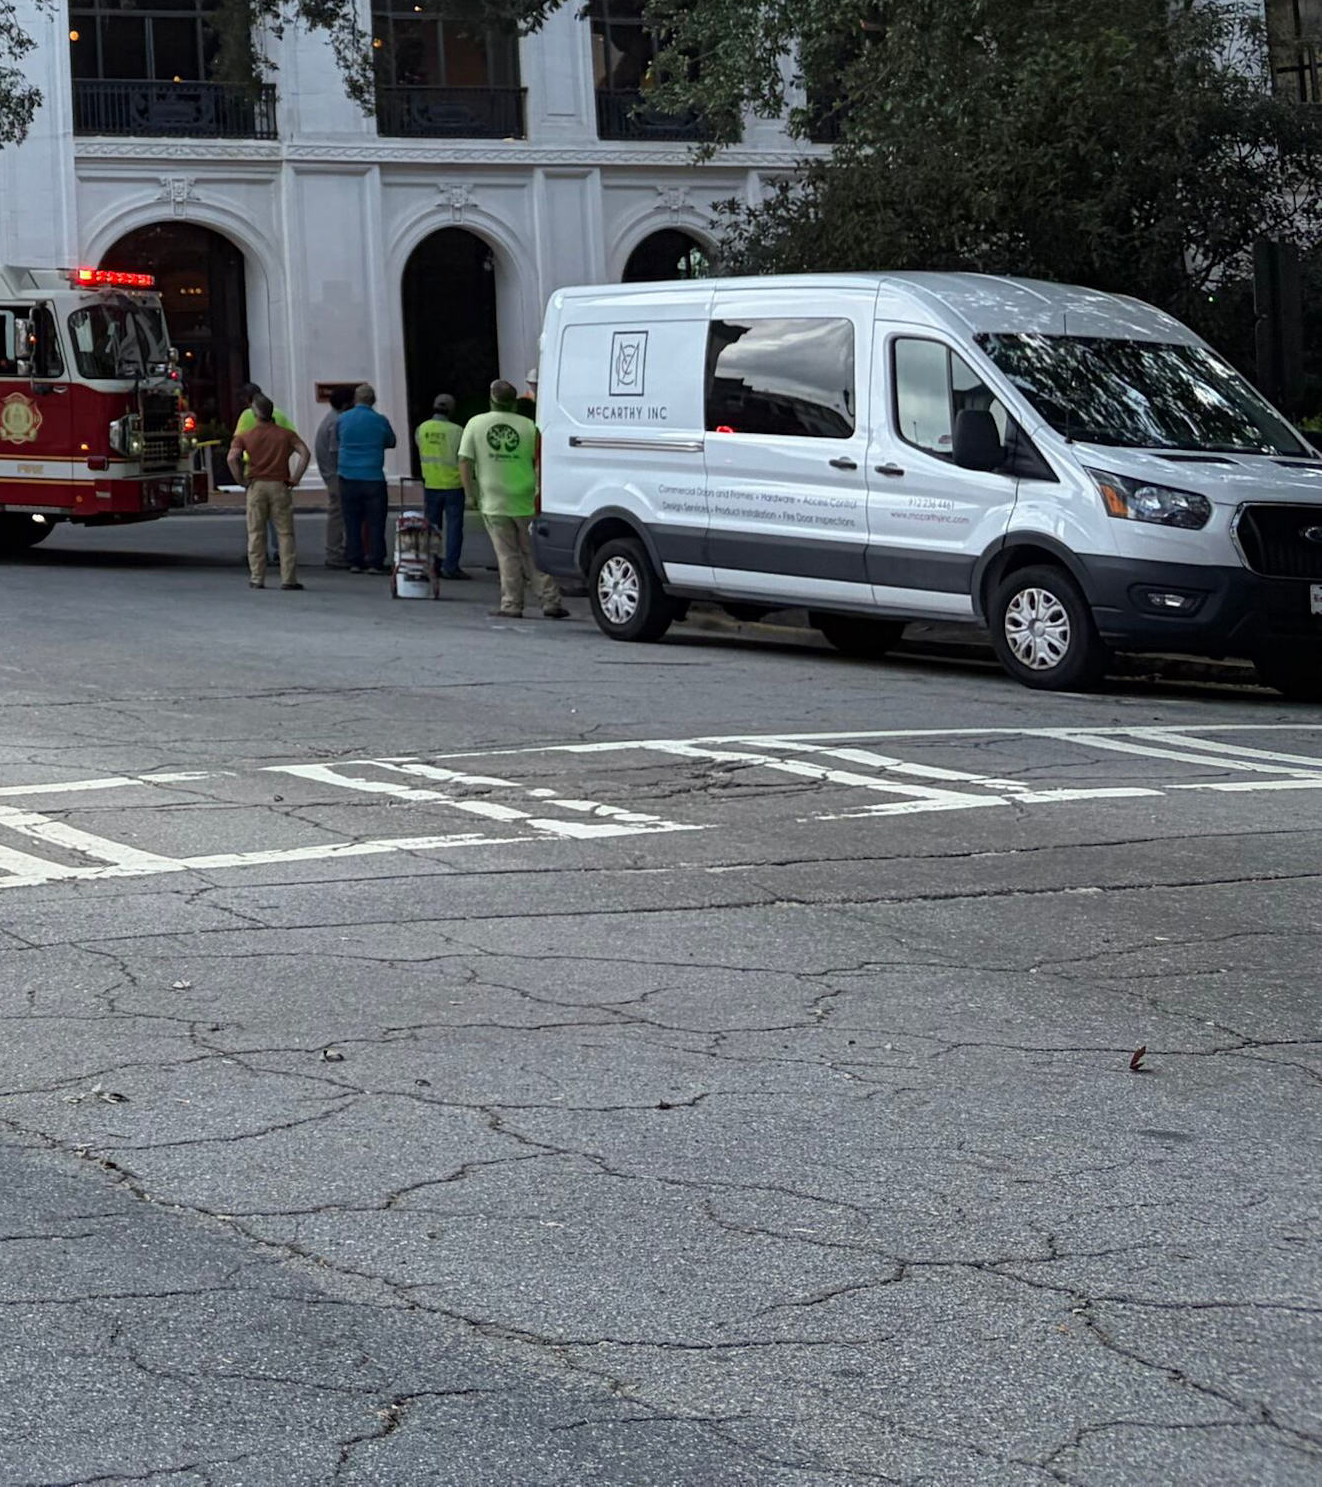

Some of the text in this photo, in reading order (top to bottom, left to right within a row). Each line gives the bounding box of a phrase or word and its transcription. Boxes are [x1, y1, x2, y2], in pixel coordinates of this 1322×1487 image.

[647, 406, 668, 420] INC
[17, 464, 44, 475] FIRE
[716, 489, 730, 498] and
[761, 493, 795, 504] Hardware
